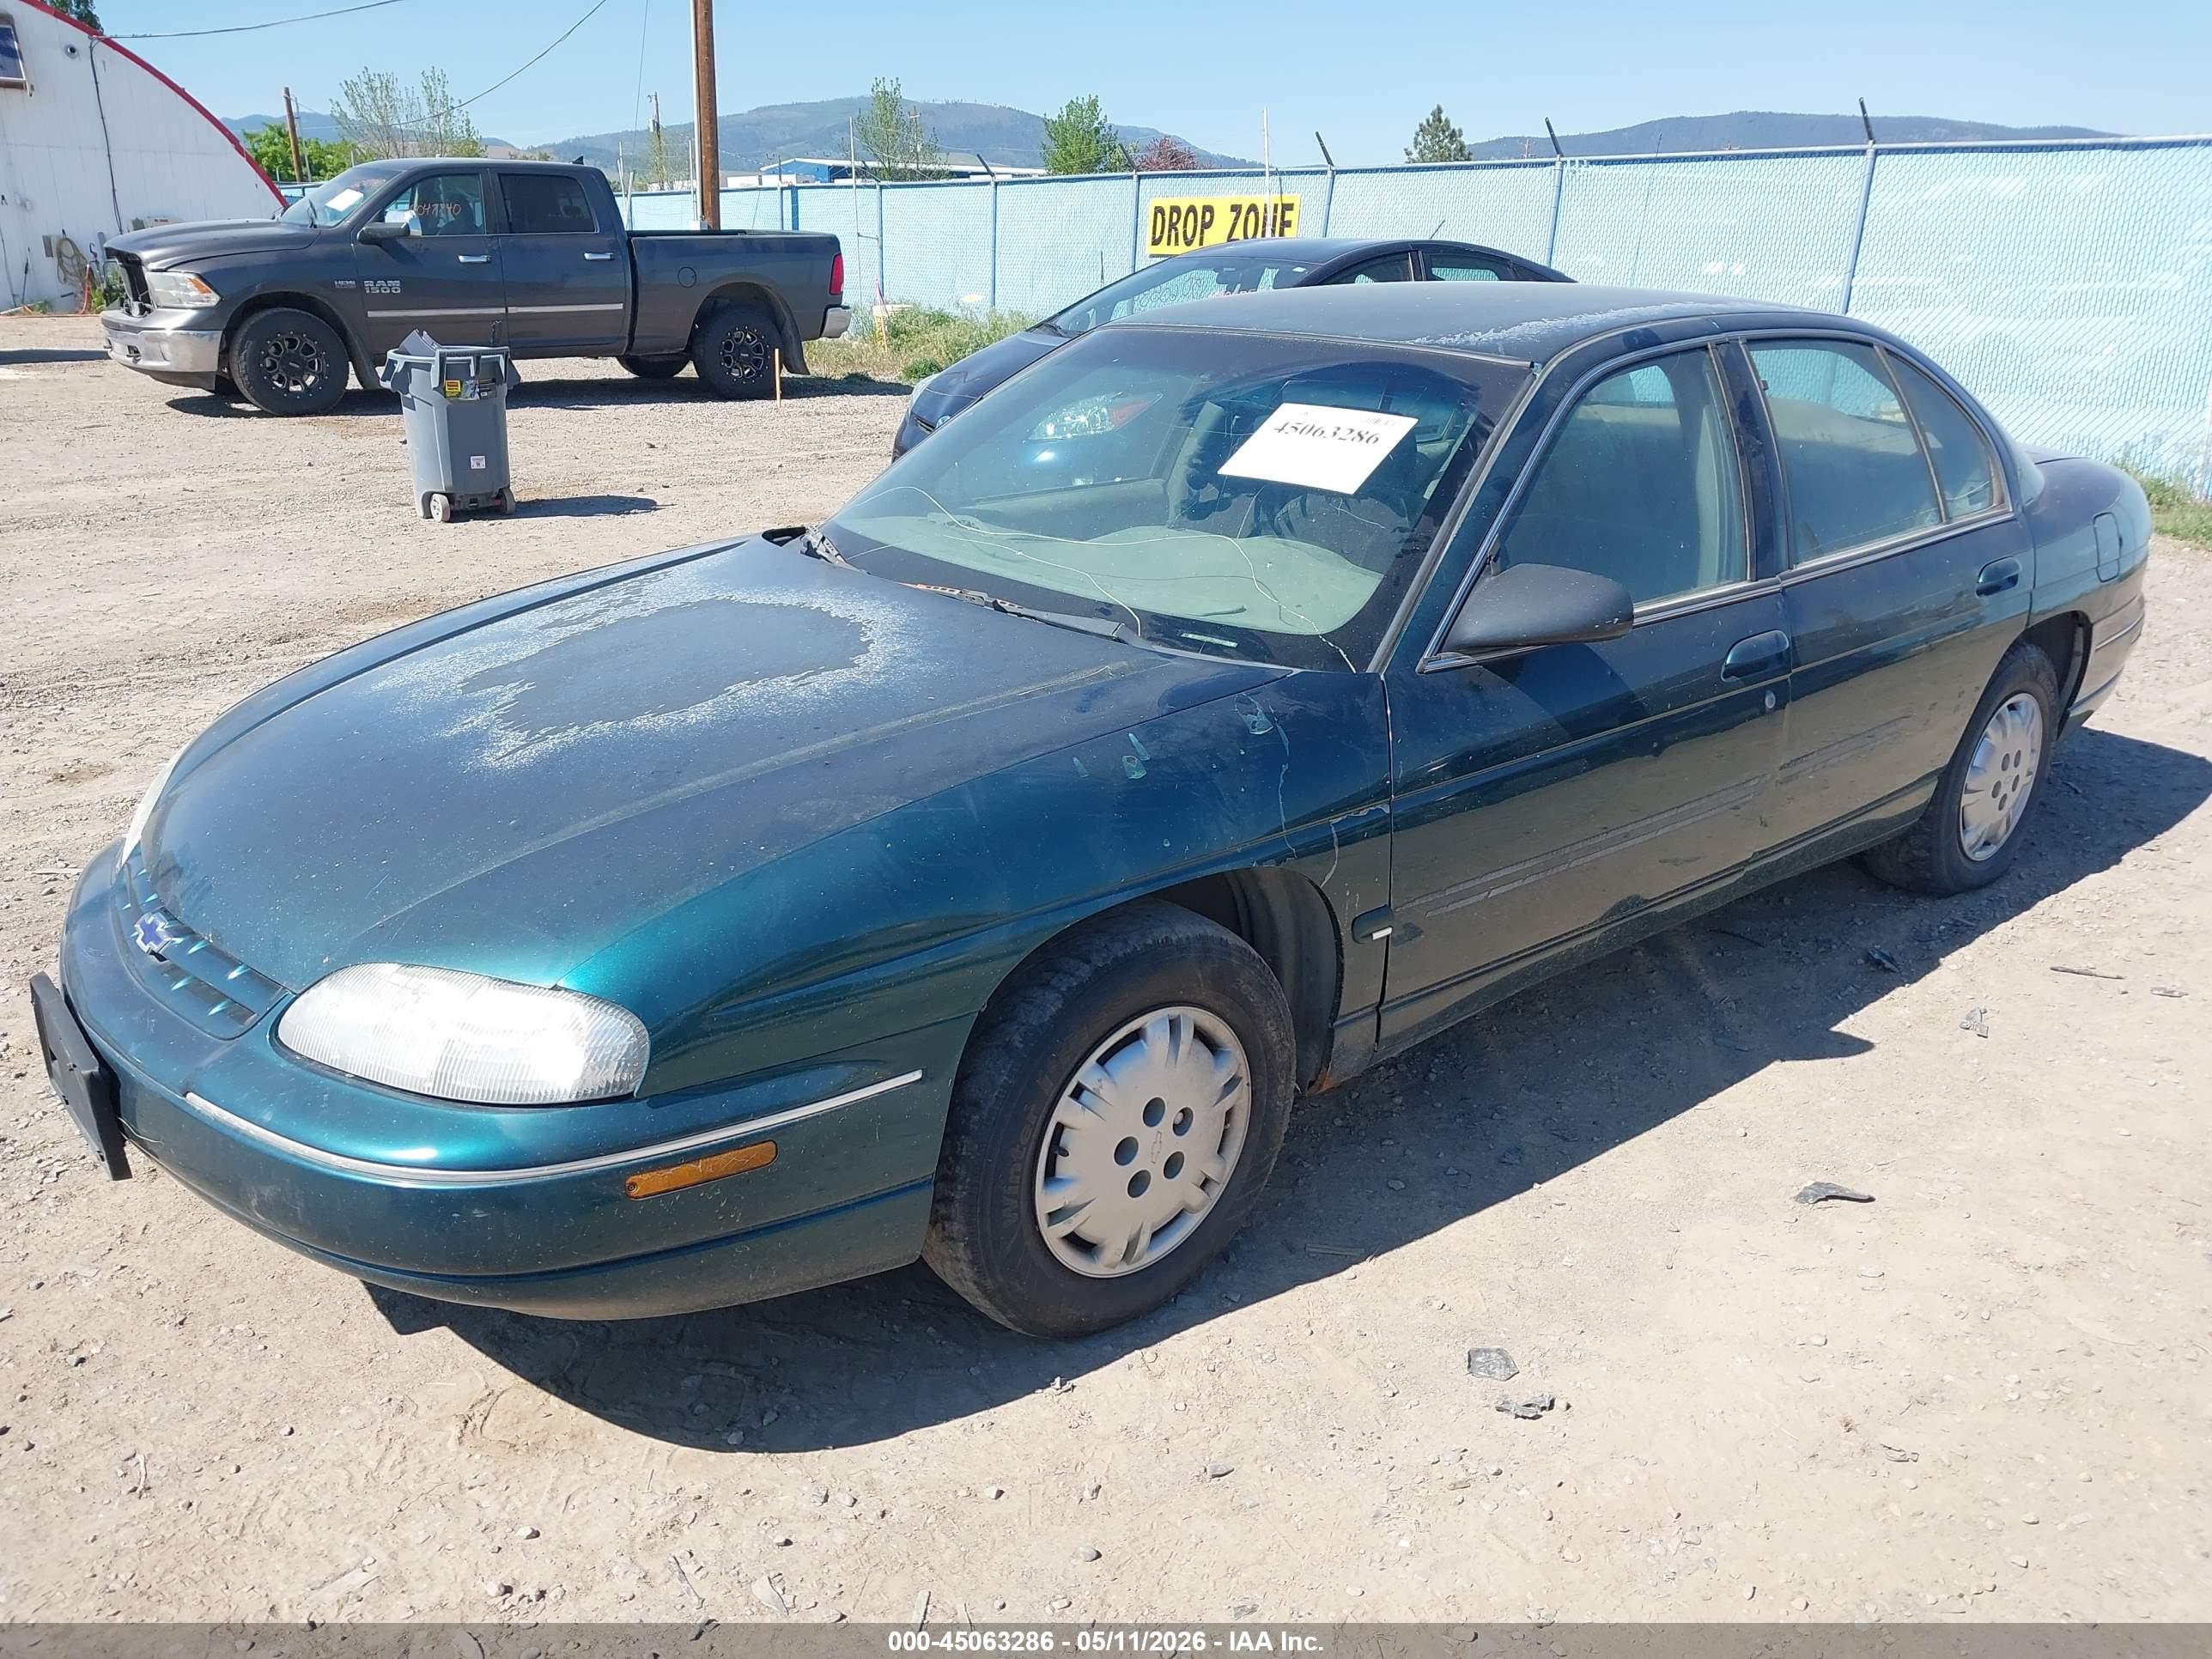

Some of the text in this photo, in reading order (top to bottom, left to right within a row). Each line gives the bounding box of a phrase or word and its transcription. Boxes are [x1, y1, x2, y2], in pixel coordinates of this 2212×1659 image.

[1151, 203, 1295, 247] DROP ZONE
[1273, 422, 1381, 445] 45063286
